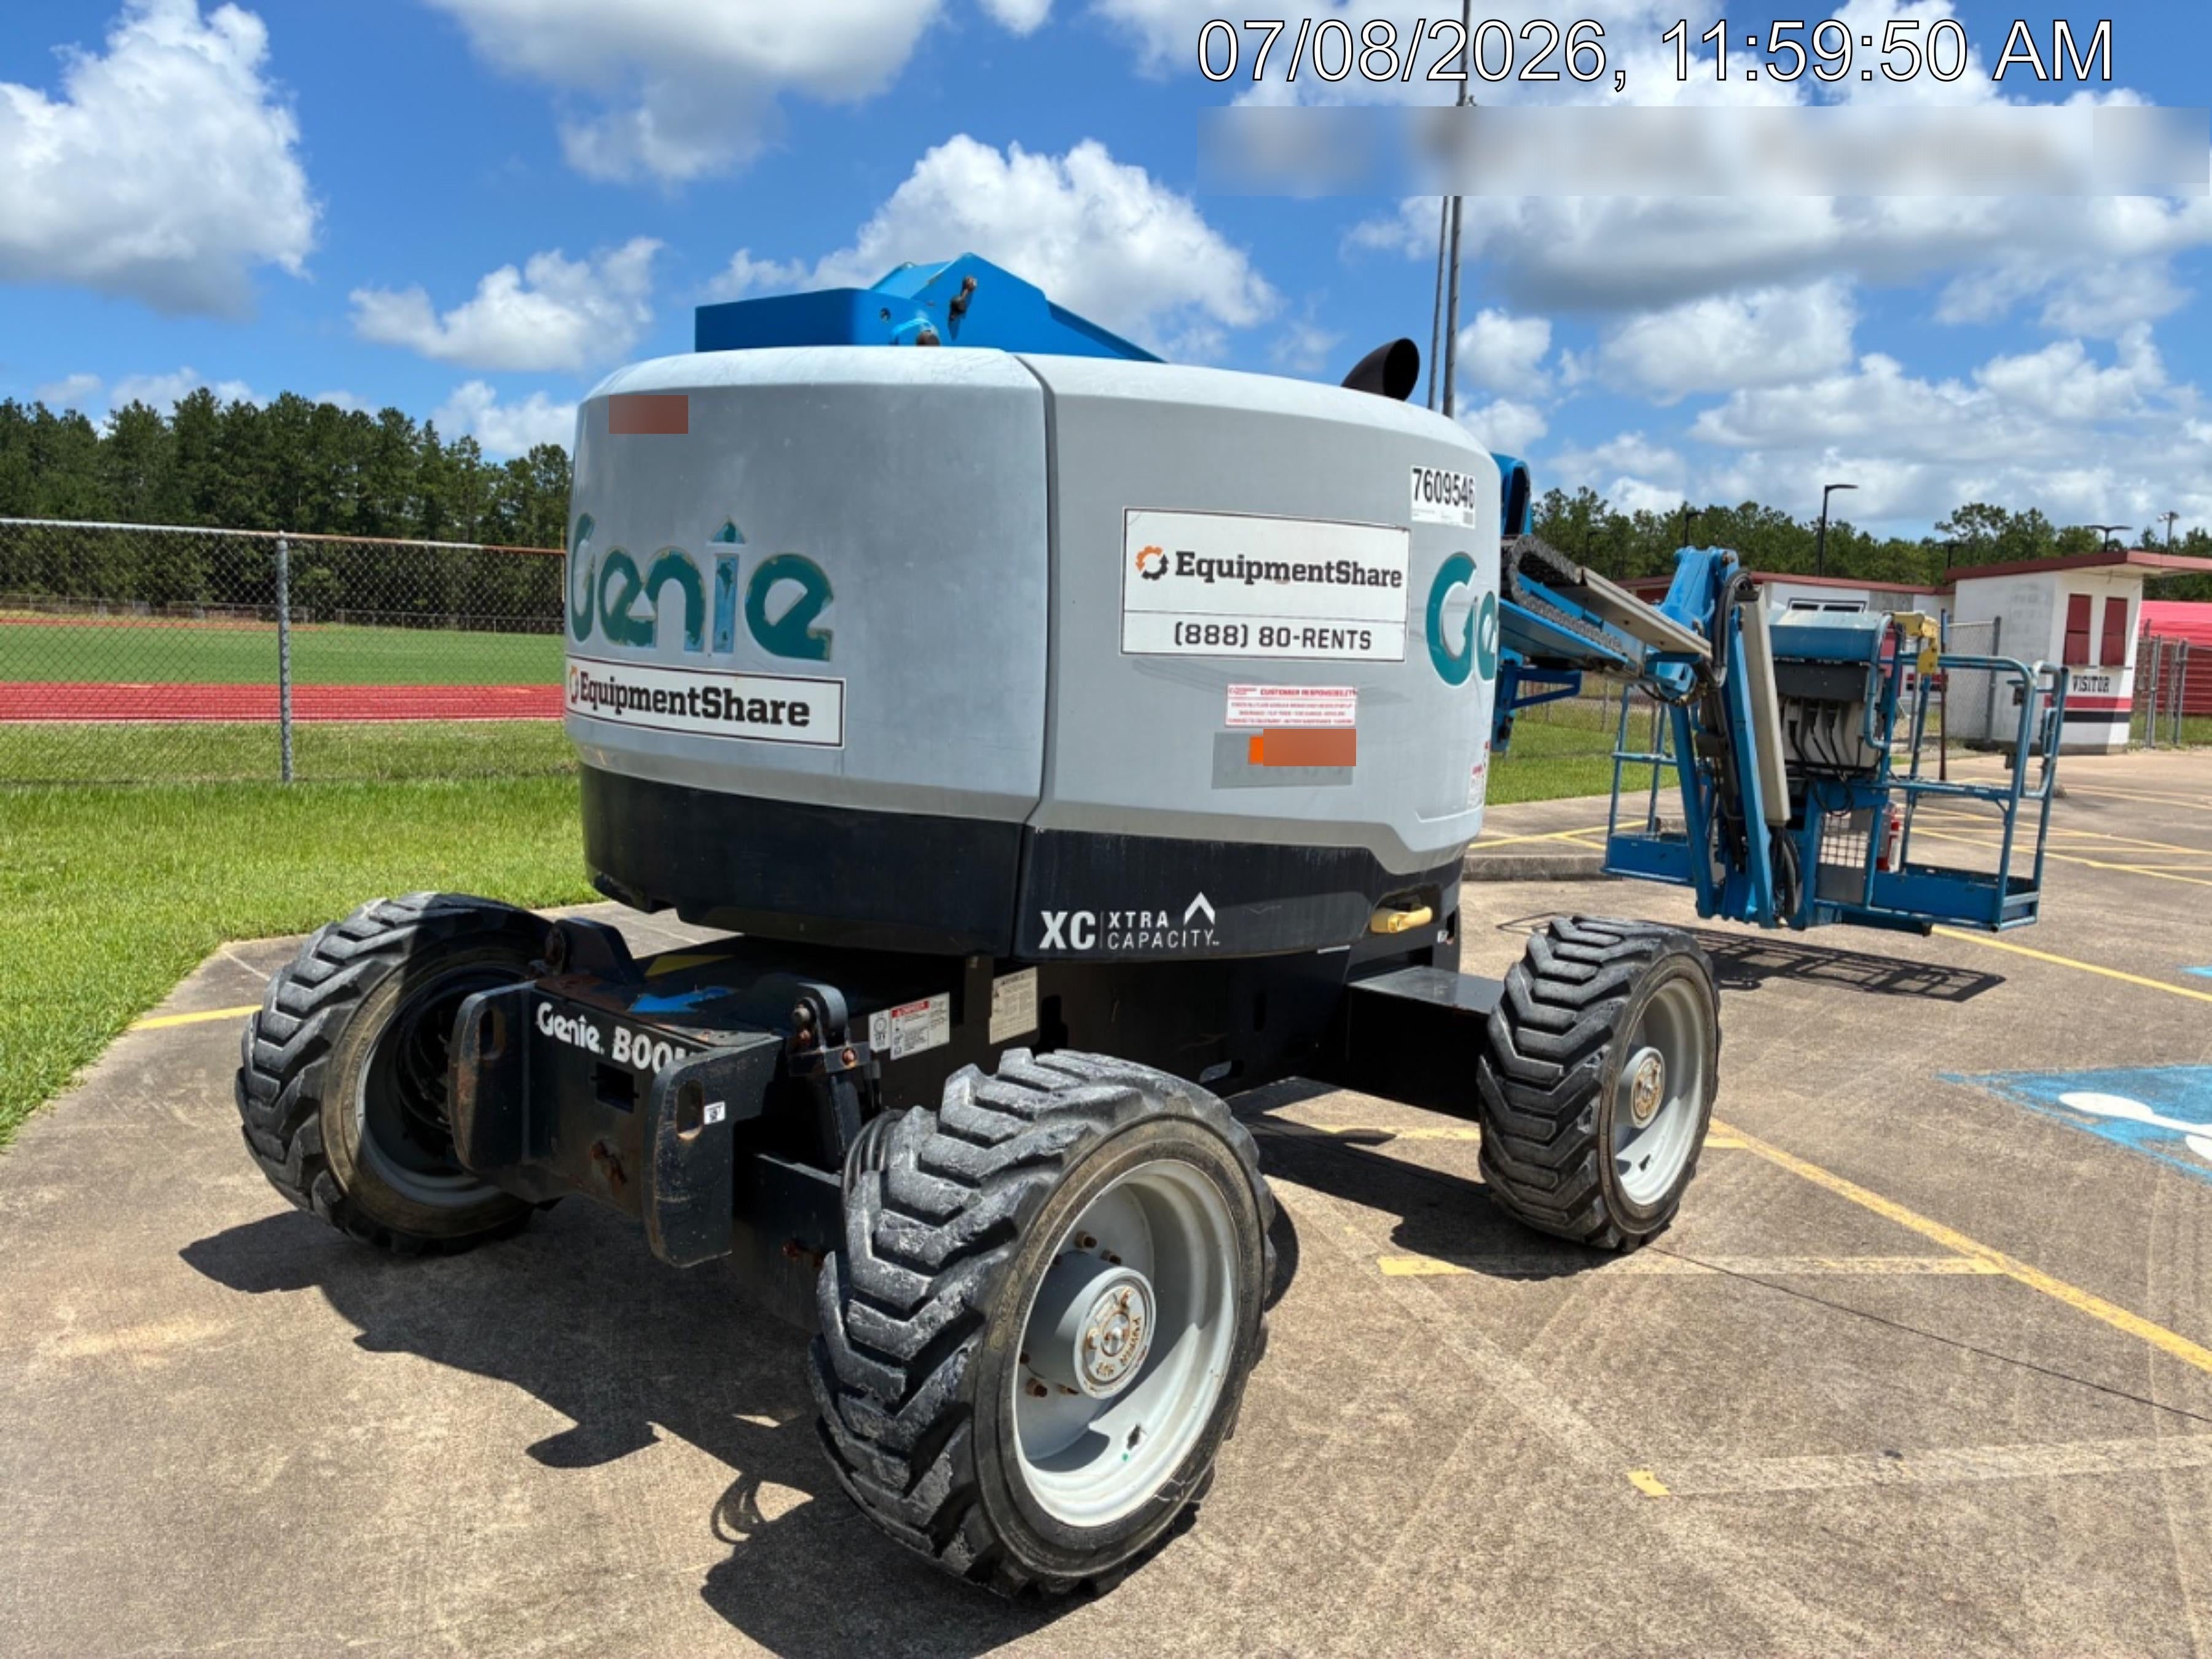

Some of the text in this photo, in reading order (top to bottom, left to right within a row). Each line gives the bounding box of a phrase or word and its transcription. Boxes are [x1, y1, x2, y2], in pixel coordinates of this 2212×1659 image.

[1413, 467, 1475, 509] 7609546
[571, 513, 834, 662] Genie
[1175, 551, 1403, 588] EquipmentShare
[1174, 621, 1372, 651] (888) 80-RENTS
[580, 670, 810, 728] EquipmentShare
[2073, 675, 2109, 692] VISITOR
[1039, 910, 1096, 950] XC
[1108, 911, 1168, 928] XTRA
[536, 1002, 600, 1054] Genie
